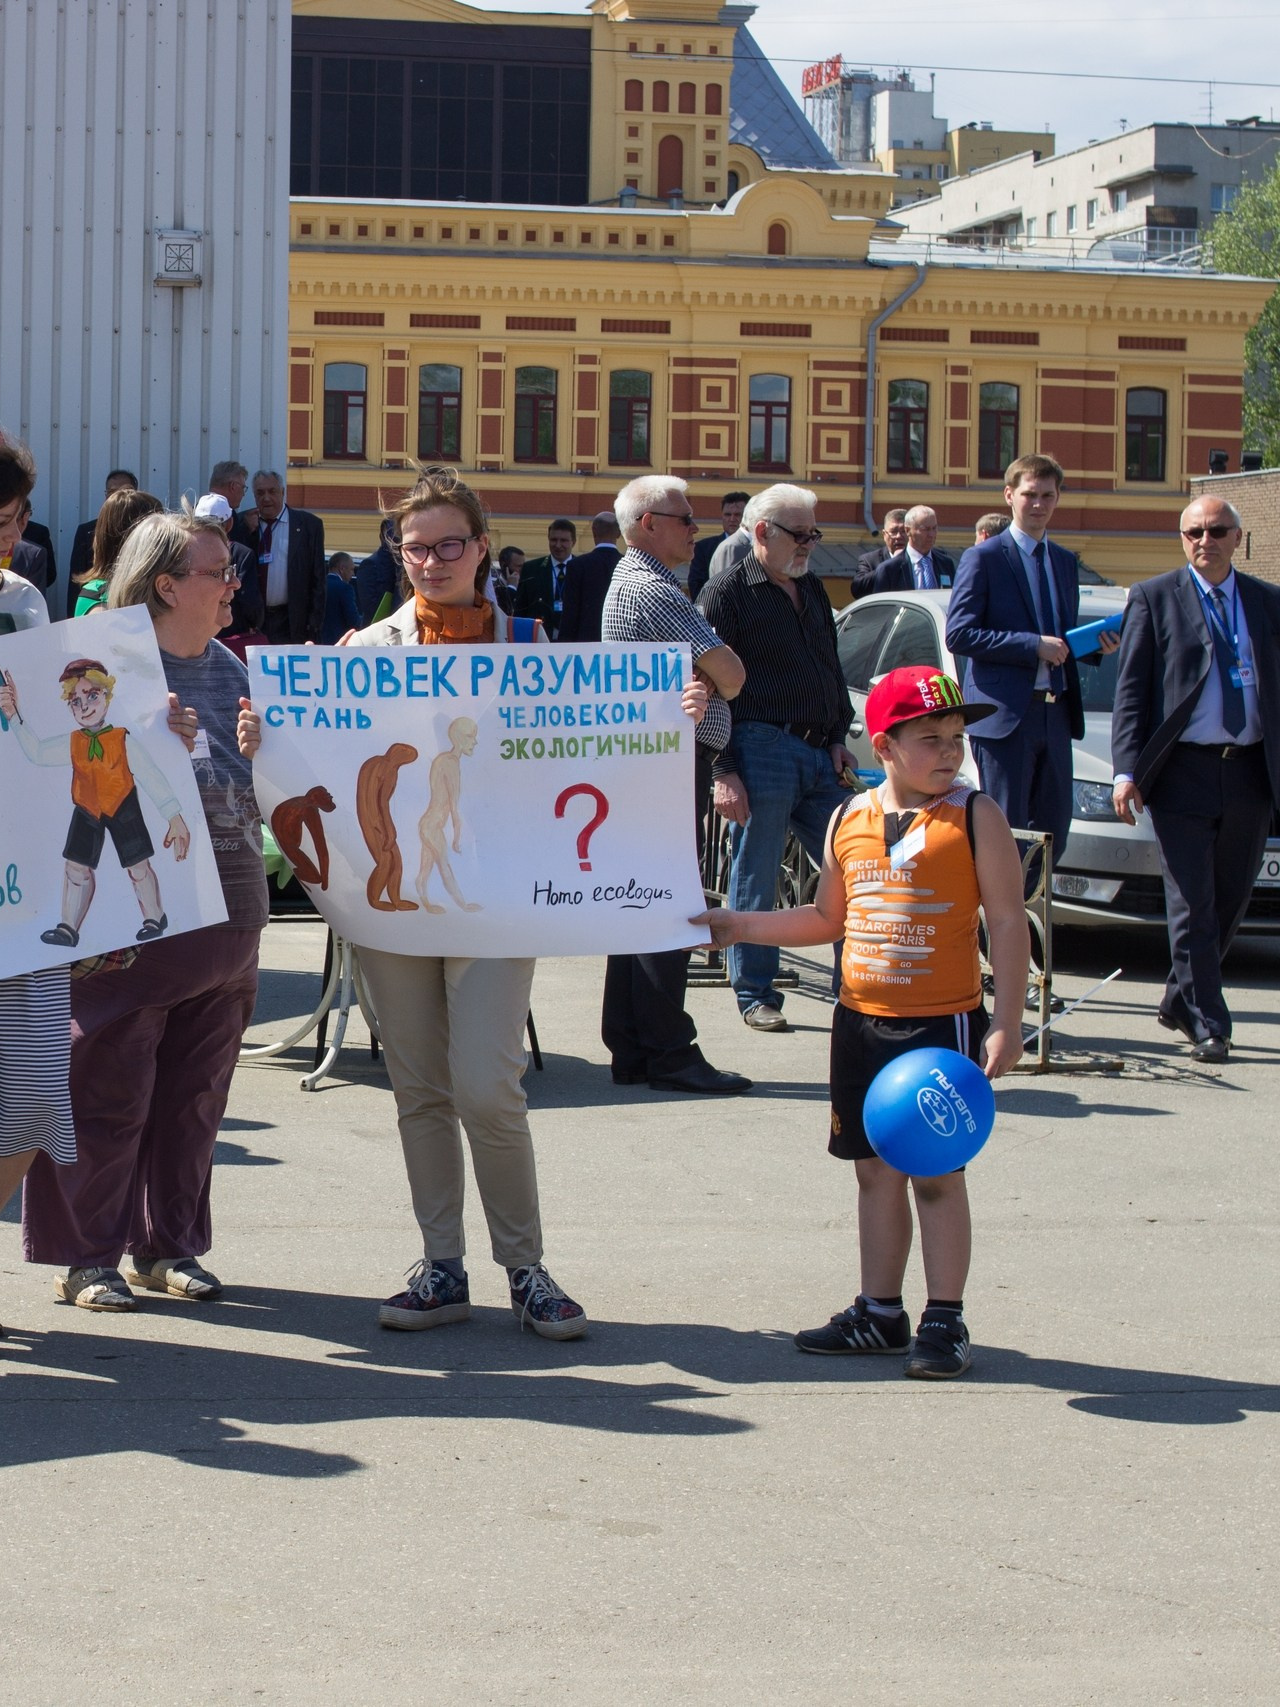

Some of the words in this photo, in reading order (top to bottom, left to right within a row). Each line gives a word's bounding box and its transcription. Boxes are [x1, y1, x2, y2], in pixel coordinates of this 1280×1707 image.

[261, 654, 459, 698] ЧЕЛОВЕК
[471, 648, 683, 697] РАЗУМНЫЙ
[265, 704, 372, 730] СТАНЬ
[498, 701, 646, 729] ЧЕЛОВЕКОМ
[500, 731, 680, 761] ЭКОЛОГИЧНЫМ
[854, 870, 912, 883] JUNIOR
[533, 880, 583, 906] Homo
[591, 878, 673, 909] ecologus
[891, 934, 926, 946] PARIS
[877, 974, 912, 985] FASHION
[929, 1068, 977, 1134] SUBARU
